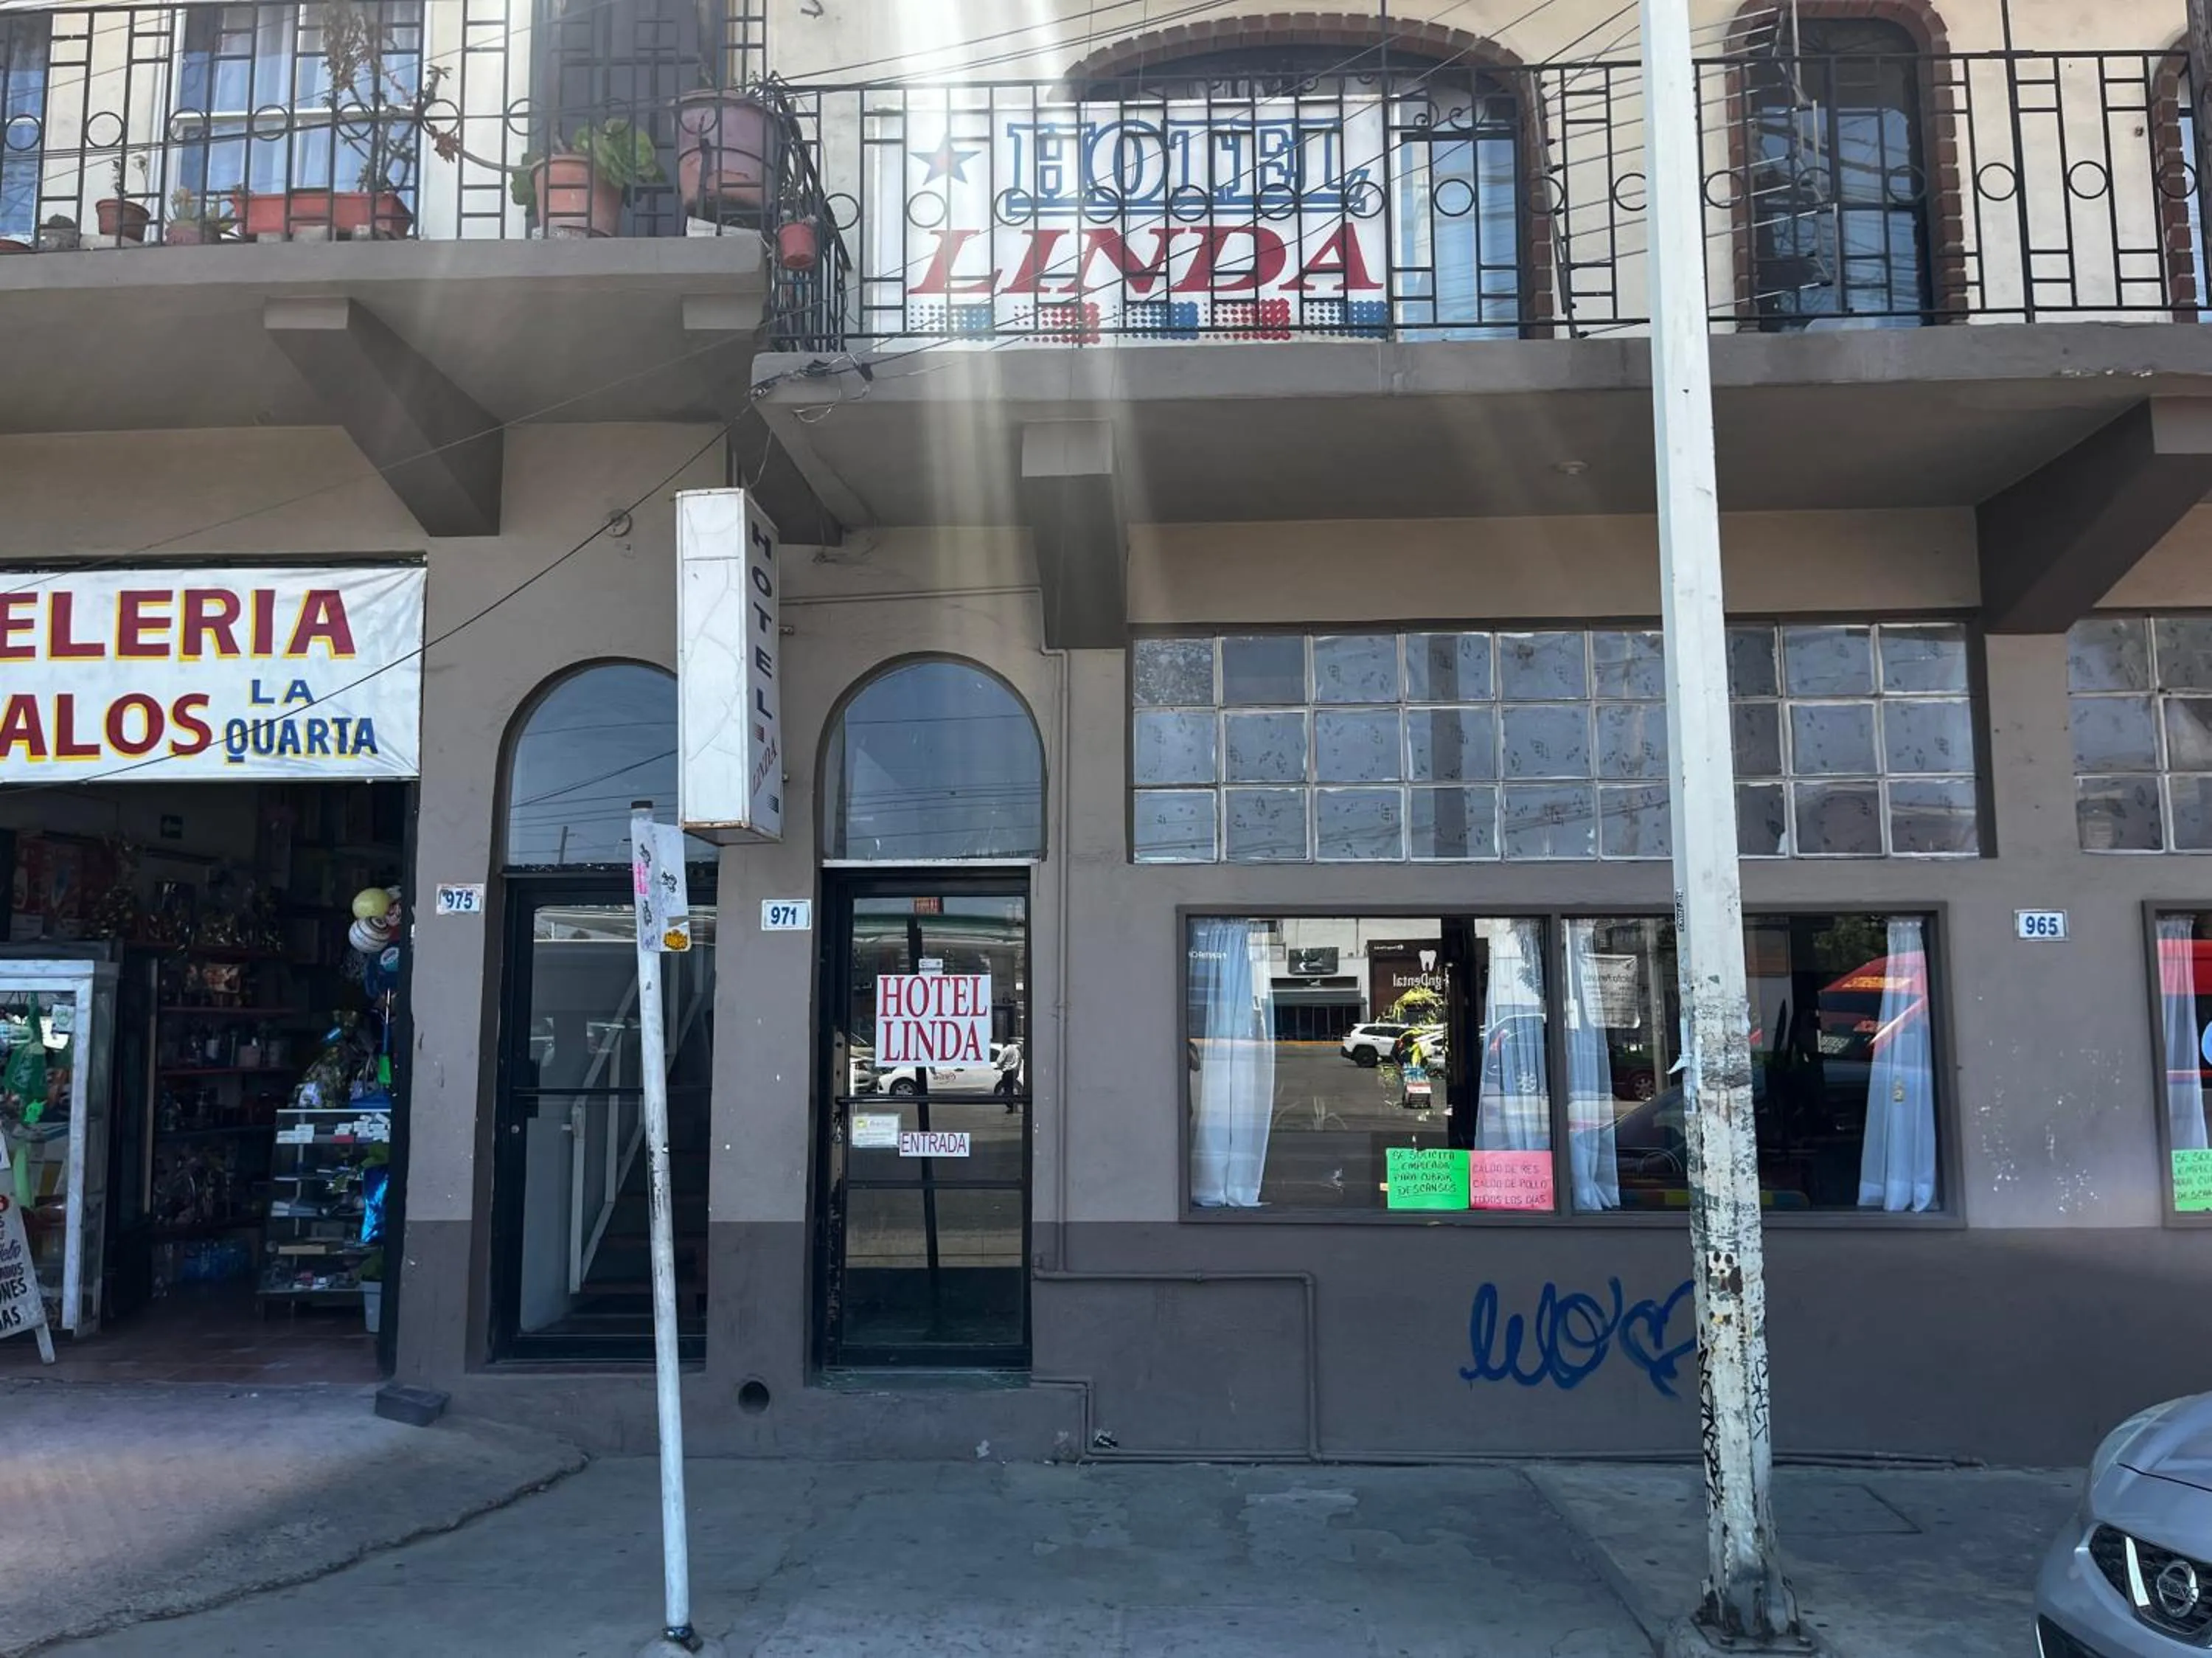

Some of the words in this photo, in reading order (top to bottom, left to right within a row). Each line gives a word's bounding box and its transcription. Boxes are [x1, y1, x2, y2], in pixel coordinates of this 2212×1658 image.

[1005, 119, 1371, 215] HOTEL
[908, 221, 1384, 294] LINDA
[0, 589, 355, 661] ELERIA
[751, 520, 773, 721] HOTEL
[248, 679, 316, 707] LA
[0, 693, 213, 762] ALOS
[445, 889, 473, 909] 975
[771, 906, 797, 926] 971
[2025, 915, 2059, 936] 965
[880, 976, 988, 1018] HOTEL
[883, 1020, 983, 1062] LINDA
[901, 1133, 967, 1154] ENTRADA
[0, 1277, 27, 1305] NES
[0, 1305, 21, 1330] AS
